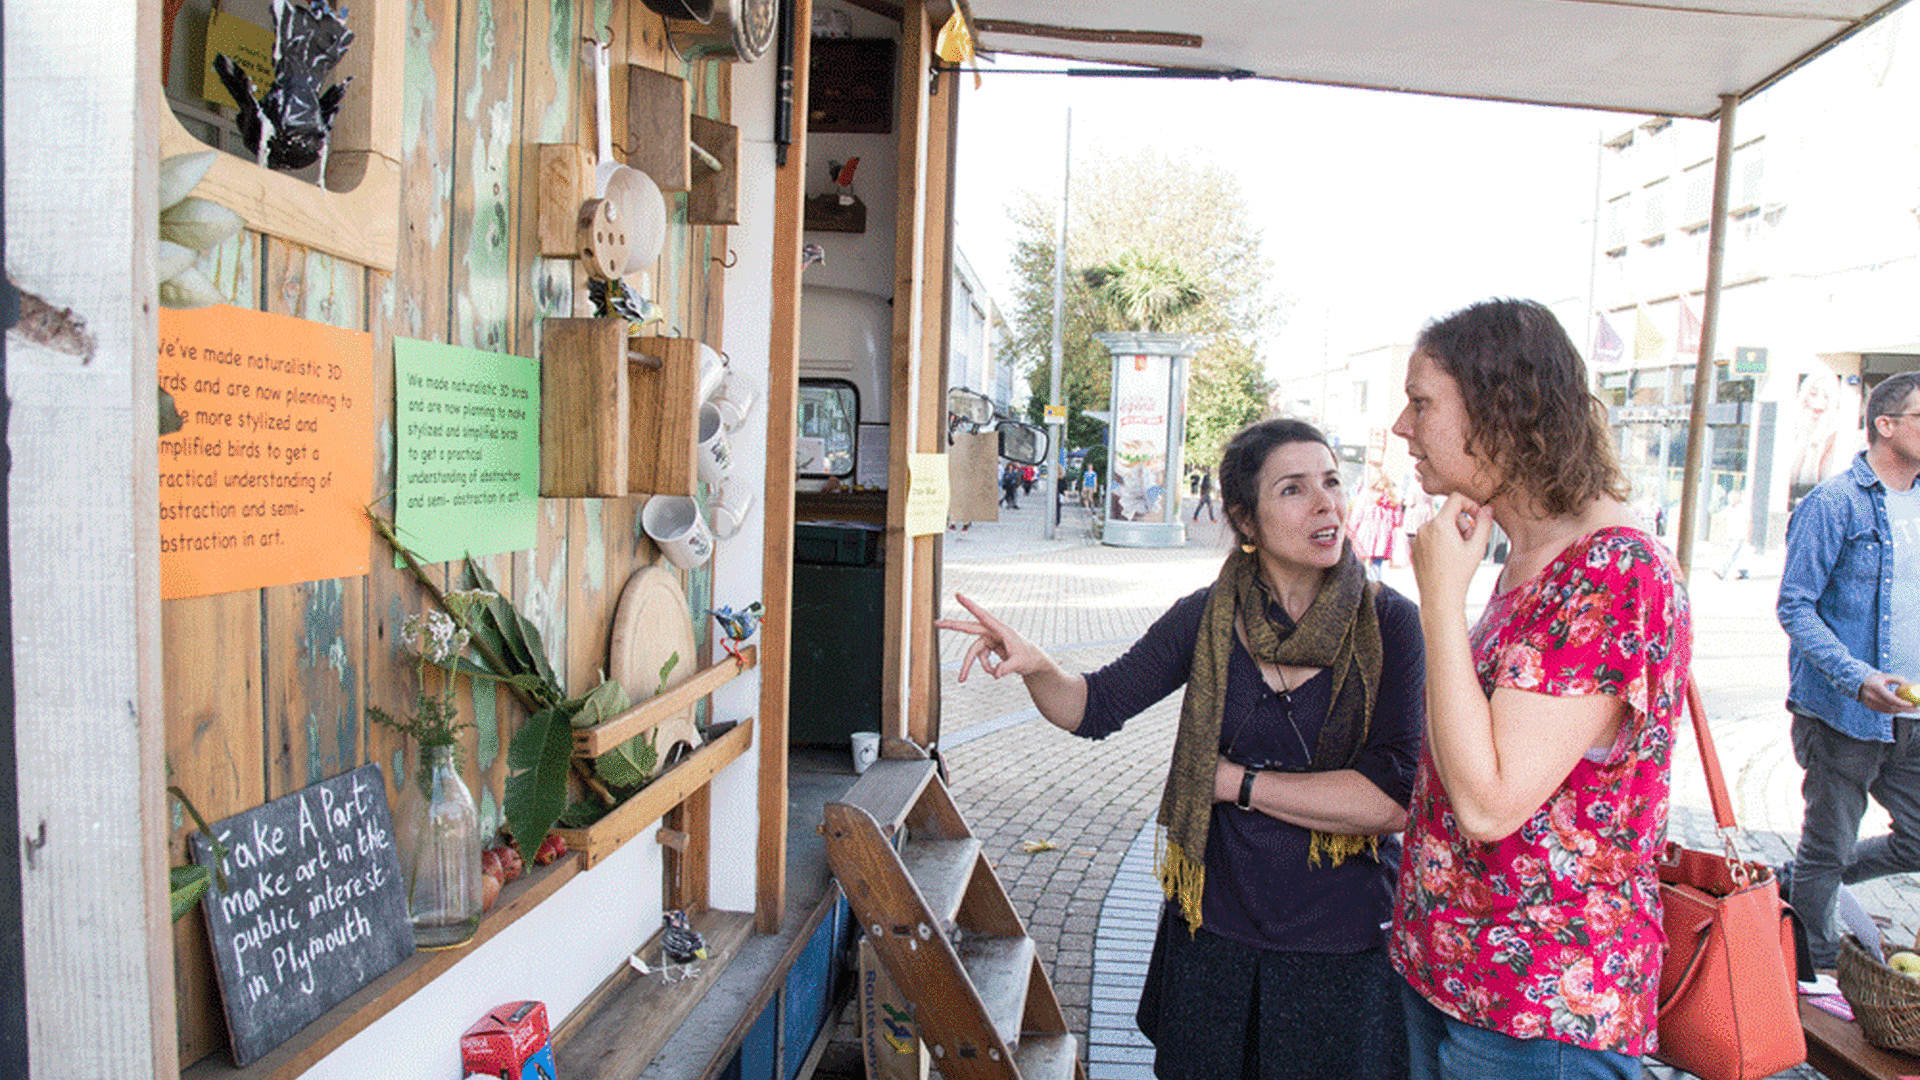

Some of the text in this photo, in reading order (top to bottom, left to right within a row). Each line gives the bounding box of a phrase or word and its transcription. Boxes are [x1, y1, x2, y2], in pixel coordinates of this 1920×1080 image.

[203, 347, 242, 366] made
[247, 354, 322, 379] naturalistic
[328, 362, 343, 381] 3D
[158, 370, 352, 412] irds and are now planning to
[407, 373, 423, 388] We
[426, 376, 449, 391] made
[452, 379, 497, 396] naturalistic
[512, 386, 529, 400] birds
[195, 410, 232, 427] more
[238, 411, 291, 433] stylized
[295, 416, 318, 433] and
[408, 398, 527, 422] and are now planning to make
[407, 421, 519, 442] stylized and simplified birds
[160, 436, 320, 466] mplified birds to get a
[408, 445, 482, 465] to get a practical
[159, 469, 332, 494] ractical understanding of
[407, 468, 521, 487] understanding of abstraction
[159, 500, 305, 520] bstraction and semi-
[407, 493, 424, 508] and
[427, 494, 450, 508] semi-
[453, 491, 497, 507] abstraction
[498, 493, 505, 503] in
[160, 529, 285, 553] bstraction in art.
[208, 818, 287, 877] Take
[299, 793, 319, 848] A
[221, 872, 291, 924] make
[295, 841, 331, 882] art
[336, 837, 353, 864] in
[232, 862, 386, 978] public interest
[247, 906, 372, 1003] in Plymouth
